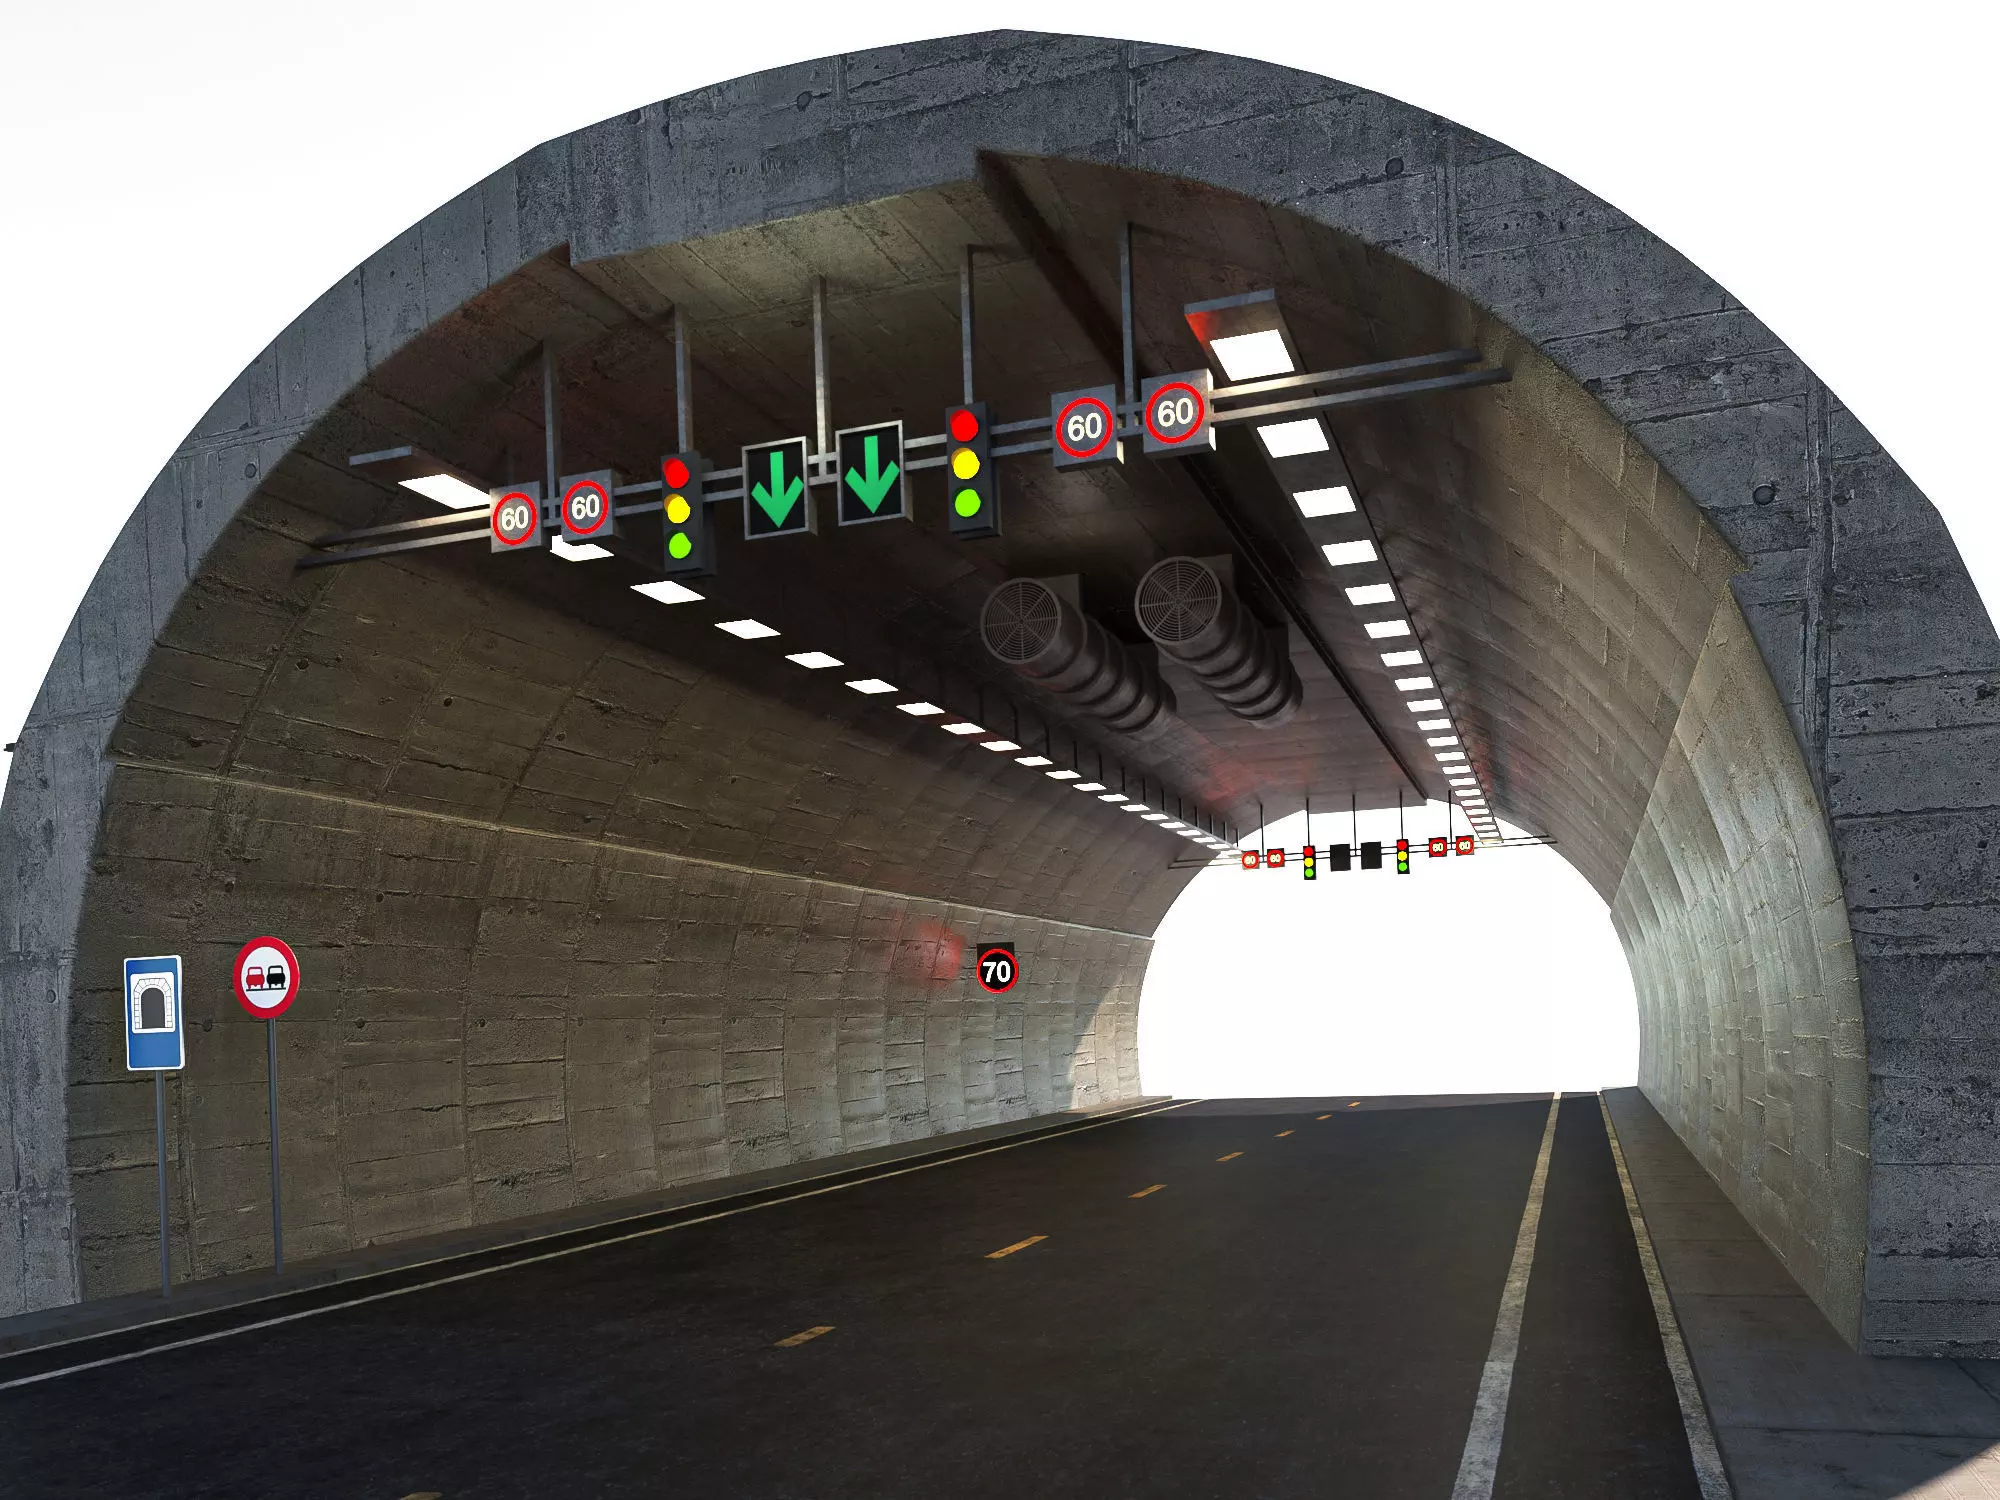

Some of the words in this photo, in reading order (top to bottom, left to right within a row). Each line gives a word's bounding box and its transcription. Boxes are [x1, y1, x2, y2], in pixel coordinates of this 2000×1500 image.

[1158, 398, 1193, 427] 60
[1068, 413, 1102, 441] 60
[502, 506, 528, 530] 60
[572, 494, 599, 520] 60
[983, 961, 1010, 982] 70
